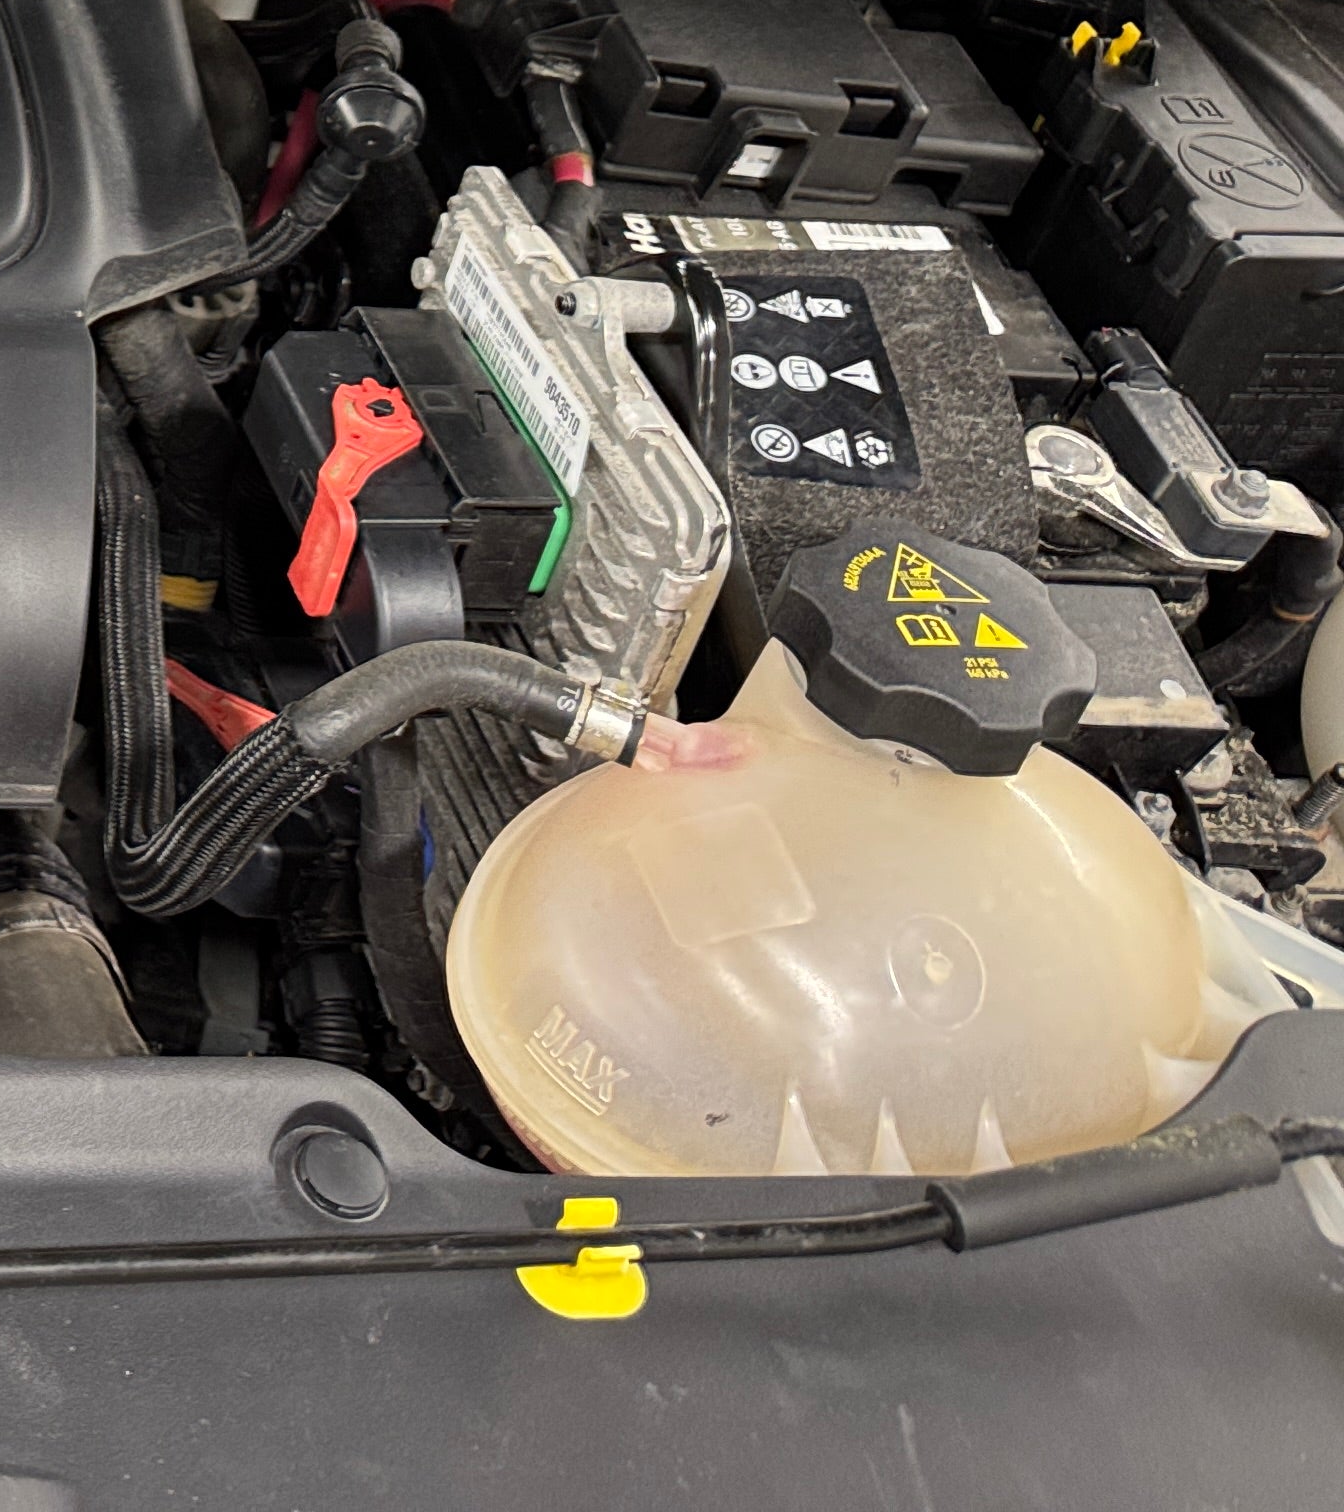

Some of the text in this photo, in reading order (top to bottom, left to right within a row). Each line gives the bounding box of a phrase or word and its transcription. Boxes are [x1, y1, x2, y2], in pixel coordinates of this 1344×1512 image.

[543, 375, 581, 437] 9043510
[963, 657, 977, 668] 21
[532, 1004, 632, 1103] MAX
